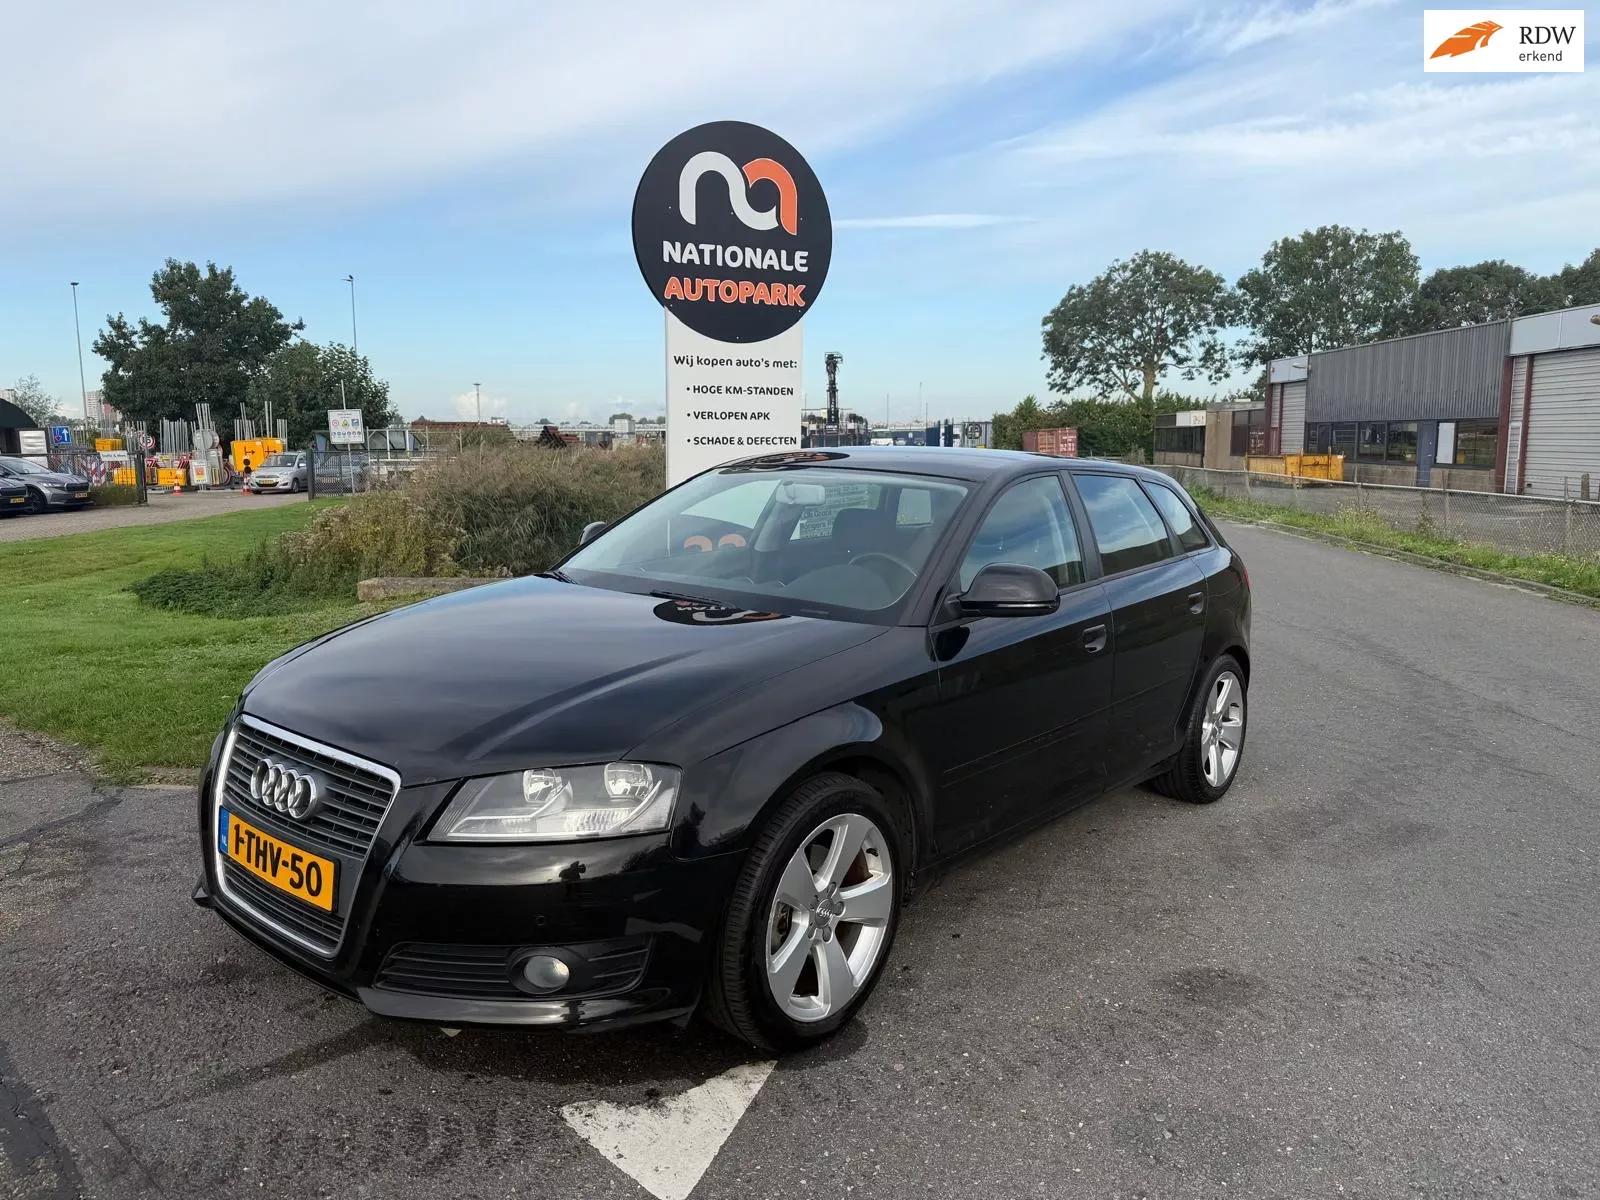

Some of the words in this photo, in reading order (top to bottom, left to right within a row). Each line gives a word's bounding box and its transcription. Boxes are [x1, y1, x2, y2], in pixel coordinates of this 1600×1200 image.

[662, 240, 809, 272] NATIONALE
[664, 276, 806, 307] AUTOPARK
[673, 355, 694, 367] Wij
[696, 355, 733, 367] kopen
[735, 357, 770, 368] auto's
[772, 359, 798, 368] met:
[693, 385, 723, 394] HOGE
[725, 386, 794, 396] KM-STANDEN
[693, 411, 747, 420] VERLOPEN
[749, 411, 771, 420] APK
[693, 436, 735, 446] SCHADE
[737, 436, 744, 446] &
[746, 436, 797, 446] DEFECTEN
[233, 823, 322, 897] 1-THV-50
